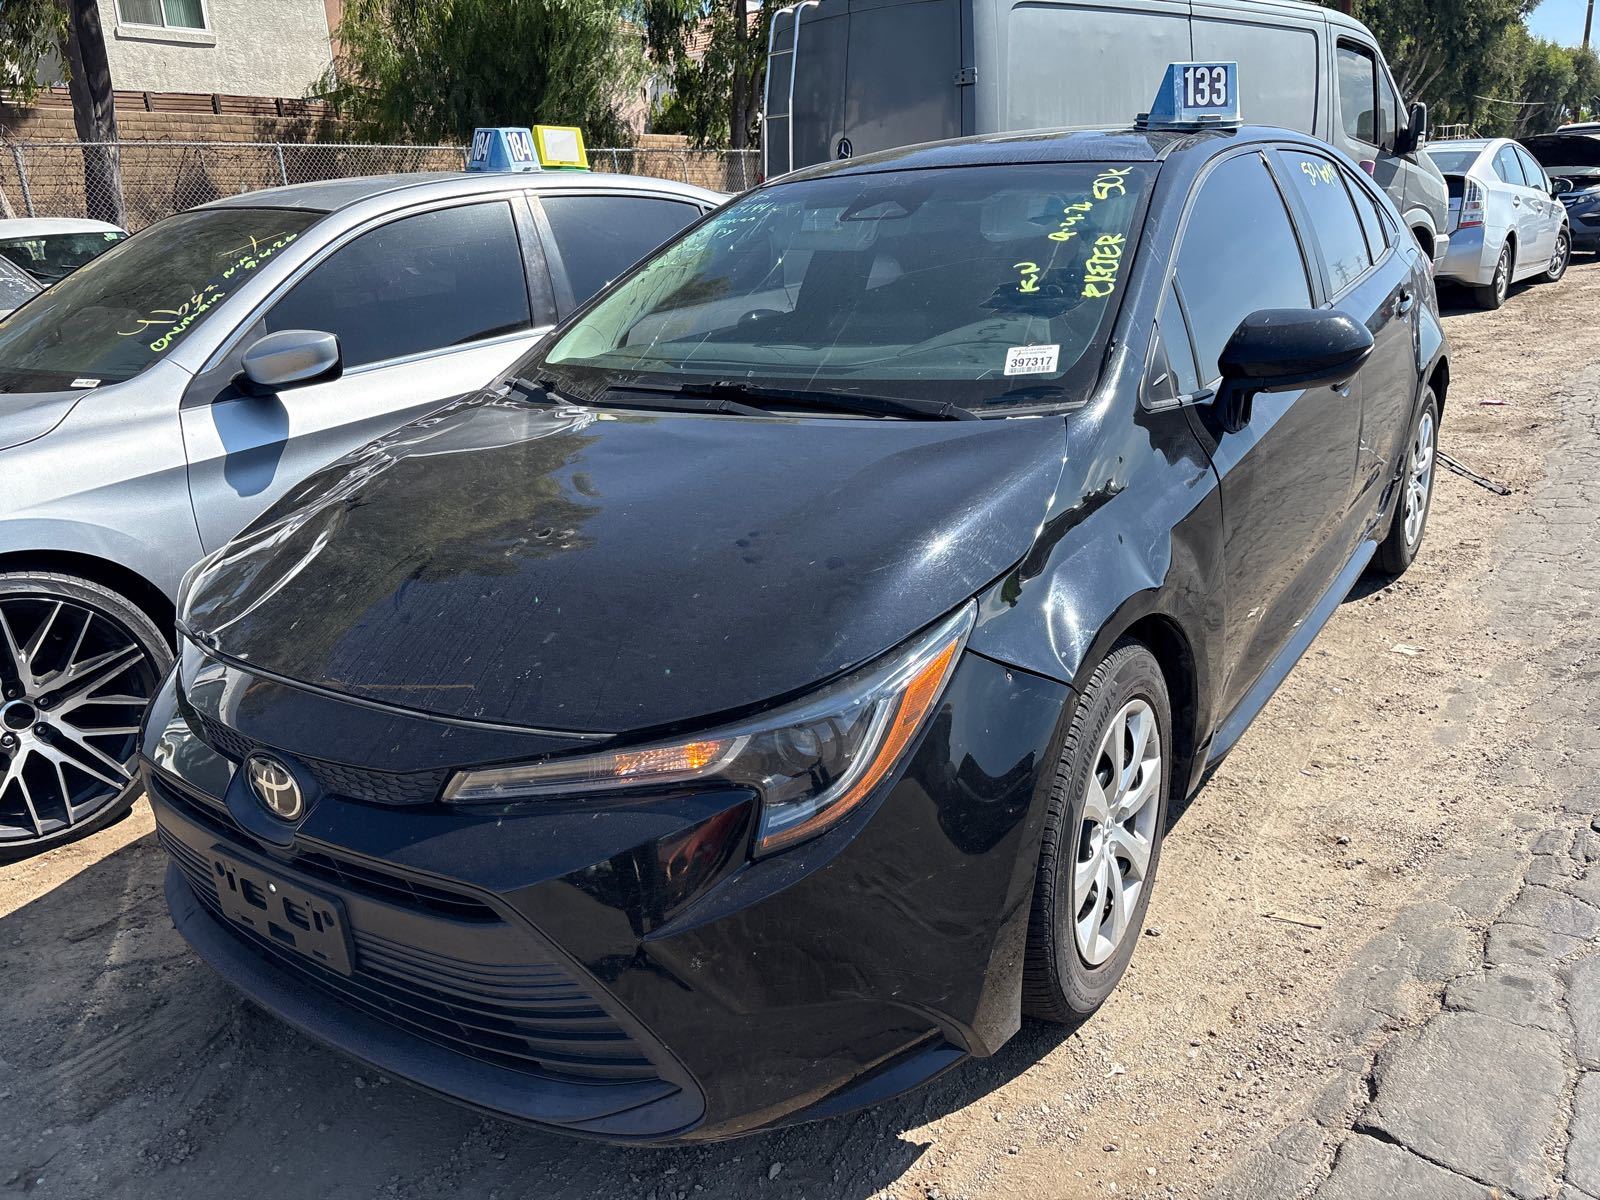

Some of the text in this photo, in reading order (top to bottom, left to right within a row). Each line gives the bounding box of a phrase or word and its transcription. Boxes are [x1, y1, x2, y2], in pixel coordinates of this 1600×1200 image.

[1185, 67, 1226, 106] 133
[474, 132, 491, 161] 184
[506, 132, 533, 161] 184
[1010, 356, 1052, 368] 397317
[1074, 697, 1117, 798] Continental
